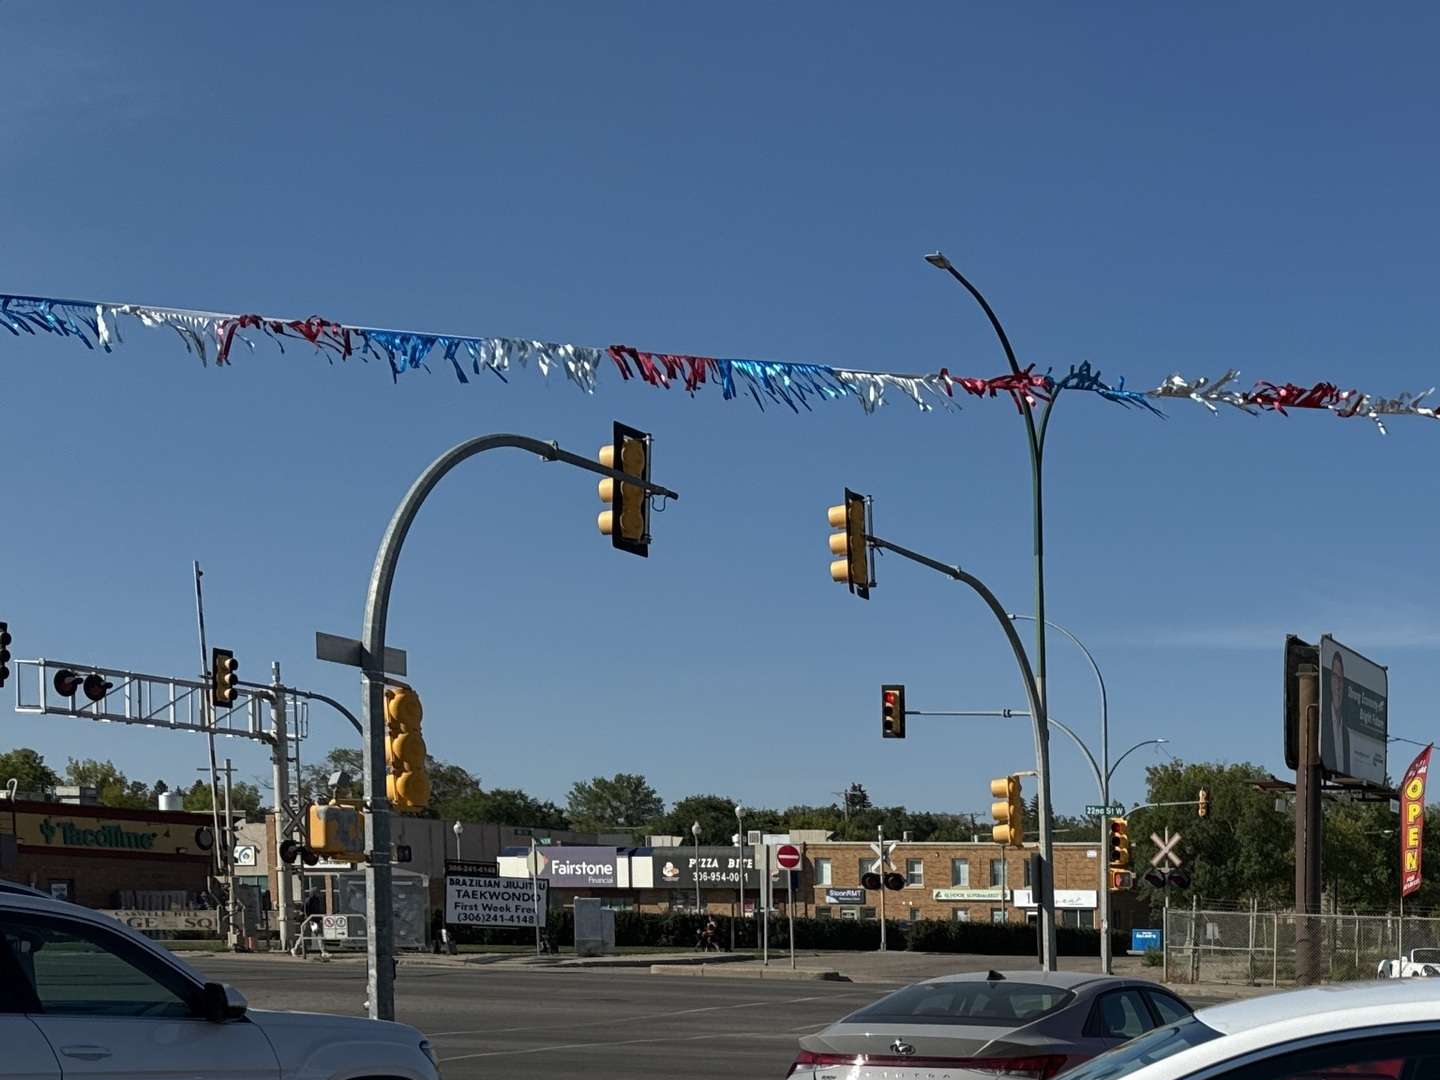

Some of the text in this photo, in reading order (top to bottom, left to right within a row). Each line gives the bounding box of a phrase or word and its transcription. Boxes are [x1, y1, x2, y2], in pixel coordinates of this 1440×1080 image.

[1116, 806, 1124, 815] W
[1405, 777, 1424, 873] OPEN
[551, 860, 613, 875] Fairstone
[688, 858, 719, 868] PZZA
[588, 876, 613, 884] Financial
[692, 871, 749, 882] 306-954-001
[449, 878, 545, 891] BRAZILIAN JIUJITU
[455, 889, 541, 902] TAEKWONDO
[454, 902, 478, 911] First
[481, 903, 512, 913] Week
[457, 912, 535, 924] (306)241-4148
